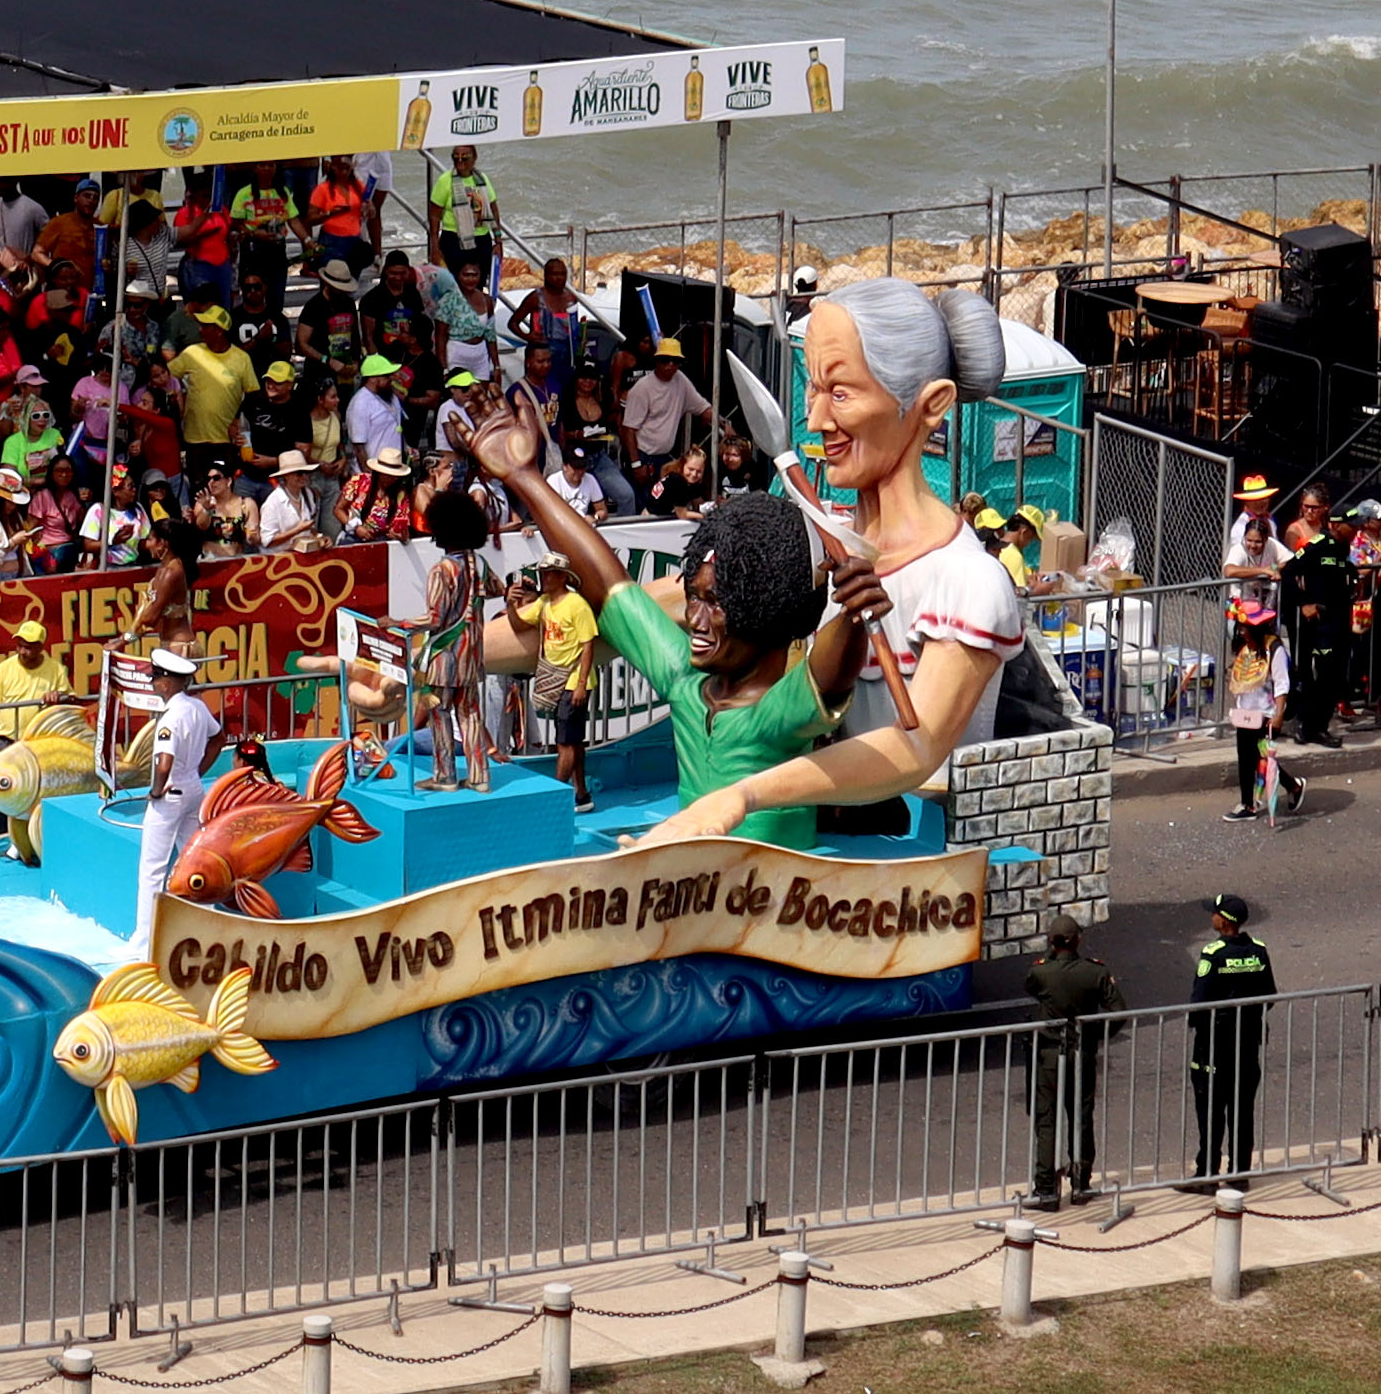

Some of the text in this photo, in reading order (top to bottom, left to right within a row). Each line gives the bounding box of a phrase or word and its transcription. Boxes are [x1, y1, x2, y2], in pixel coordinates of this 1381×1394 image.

[582, 61, 655, 89] Aguardiente
[727, 60, 772, 89] VIVE
[452, 86, 499, 111] VIVE
[570, 83, 661, 124] AMARILLO
[727, 91, 771, 109] FRONTERAS
[217, 109, 309, 126] Alcaldía Mayor de
[452, 116, 497, 134] FRONTERAS
[33, 128, 56, 147] QUE
[61, 126, 86, 146] NOS
[88, 117, 130, 149] UNE
[210, 122, 316, 143] Cartagena de Indias
[355, 931, 455, 985] Vivo
[479, 886, 628, 961] Itmina
[636, 870, 721, 931] Fanti
[726, 867, 771, 917] de
[776, 876, 977, 939] Bocachica
